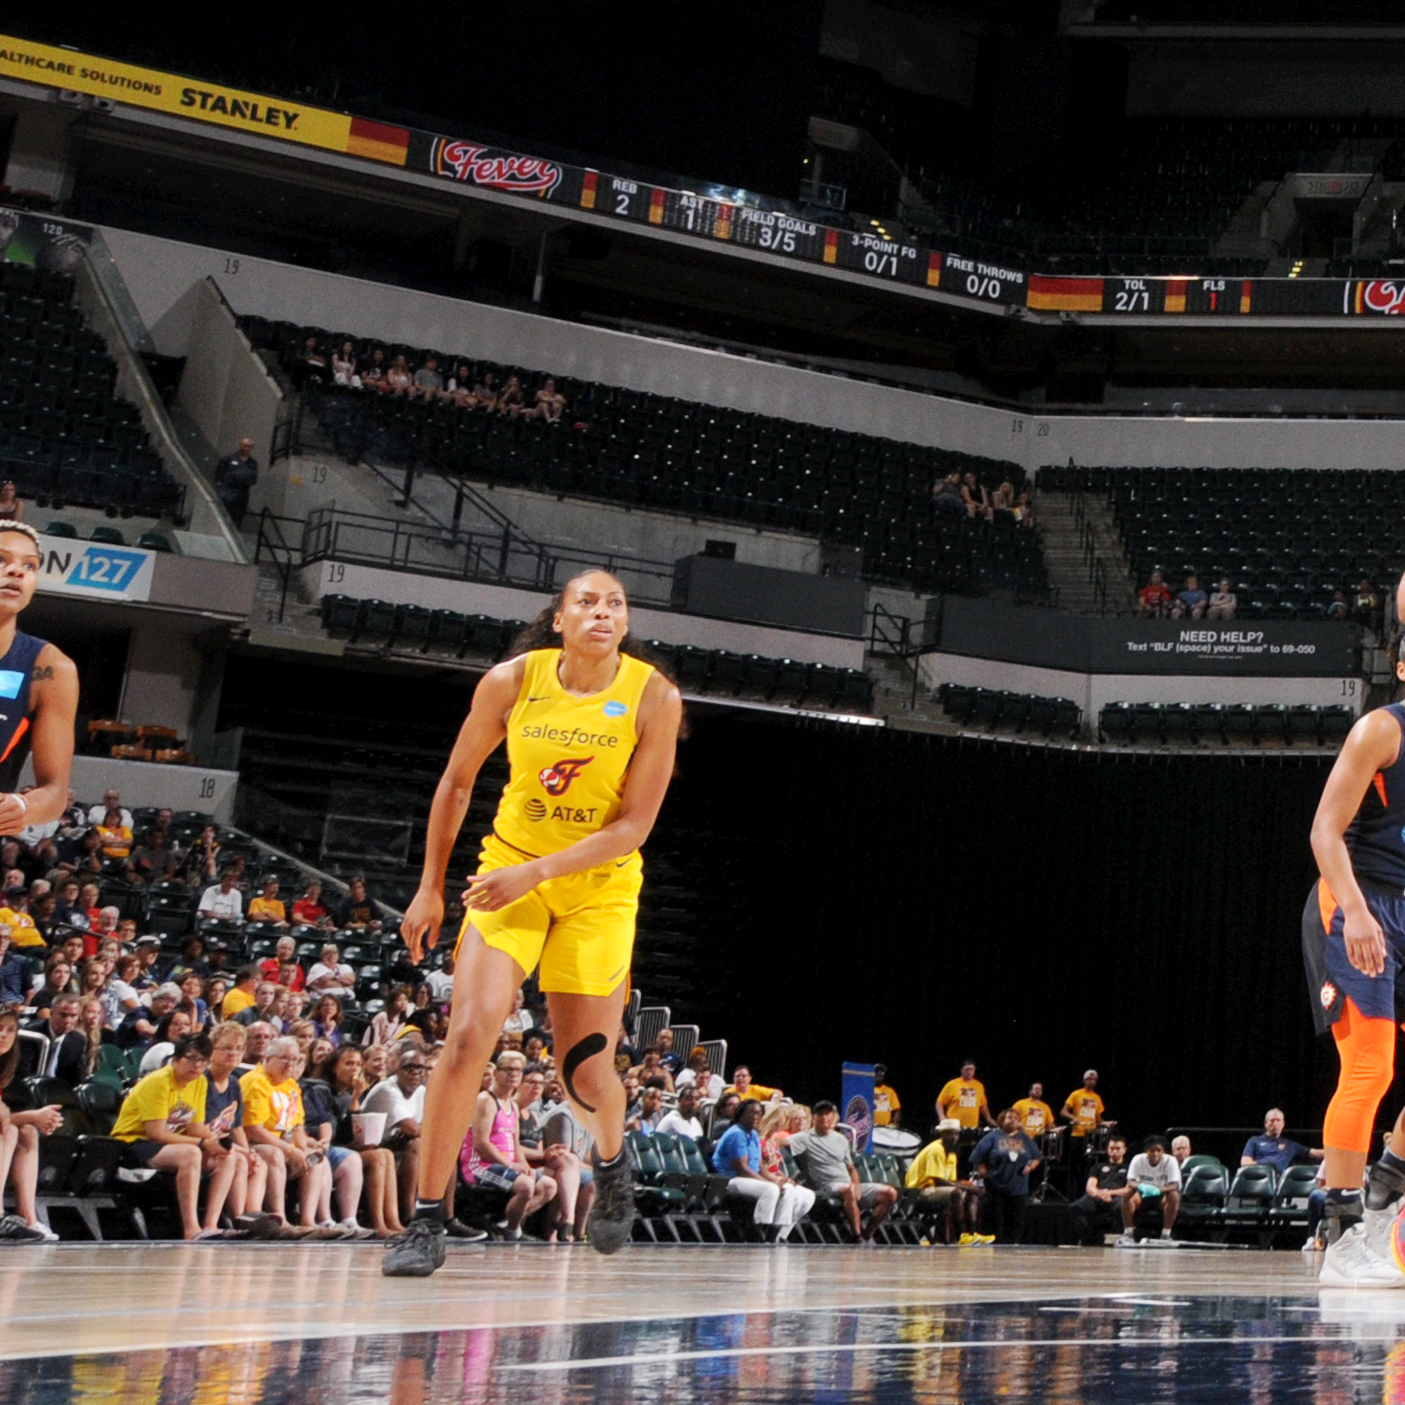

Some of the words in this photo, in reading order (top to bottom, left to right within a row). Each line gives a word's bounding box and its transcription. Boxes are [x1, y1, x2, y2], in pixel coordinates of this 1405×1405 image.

[80, 68, 163, 96] SOLUTIONS
[180, 87, 300, 131] STANLEY
[444, 140, 560, 191] Fever
[612, 179, 638, 194] REB
[615, 196, 628, 214] 2
[680, 196, 703, 209] AST
[686, 210, 694, 229] 1
[741, 209, 775, 226] FIELD
[777, 219, 816, 236] GOALS
[758, 228, 796, 252] 3/5
[852, 234, 899, 255] 3-POINT
[901, 244, 916, 258] FG
[865, 252, 898, 276] 0/1
[946, 256, 974, 274] FREE
[977, 262, 1023, 284] THROWS
[966, 275, 1001, 298] 0/0
[1123, 279, 1146, 291] TOL
[1203, 279, 1226, 291] FLS
[1115, 292, 1149, 311] 2/1
[1209, 293, 1216, 311] 1
[1012, 420, 1023, 433] 19
[1037, 422, 1049, 437] 20
[312, 466, 327, 484] 19
[79, 555, 132, 584] 127
[328, 564, 345, 583] 19
[1180, 631, 1217, 642] NEED
[1221, 631, 1263, 643] HELP?
[1127, 642, 1148, 651] Text
[1176, 643, 1211, 654] (space)
[1213, 645, 1235, 654] your
[1270, 645, 1280, 654] to
[1282, 645, 1316, 654] 69-050
[1341, 679, 1355, 695] 19
[521, 724, 618, 748] salesforce
[200, 778, 215, 798] 18
[551, 806, 597, 823] AT&T
